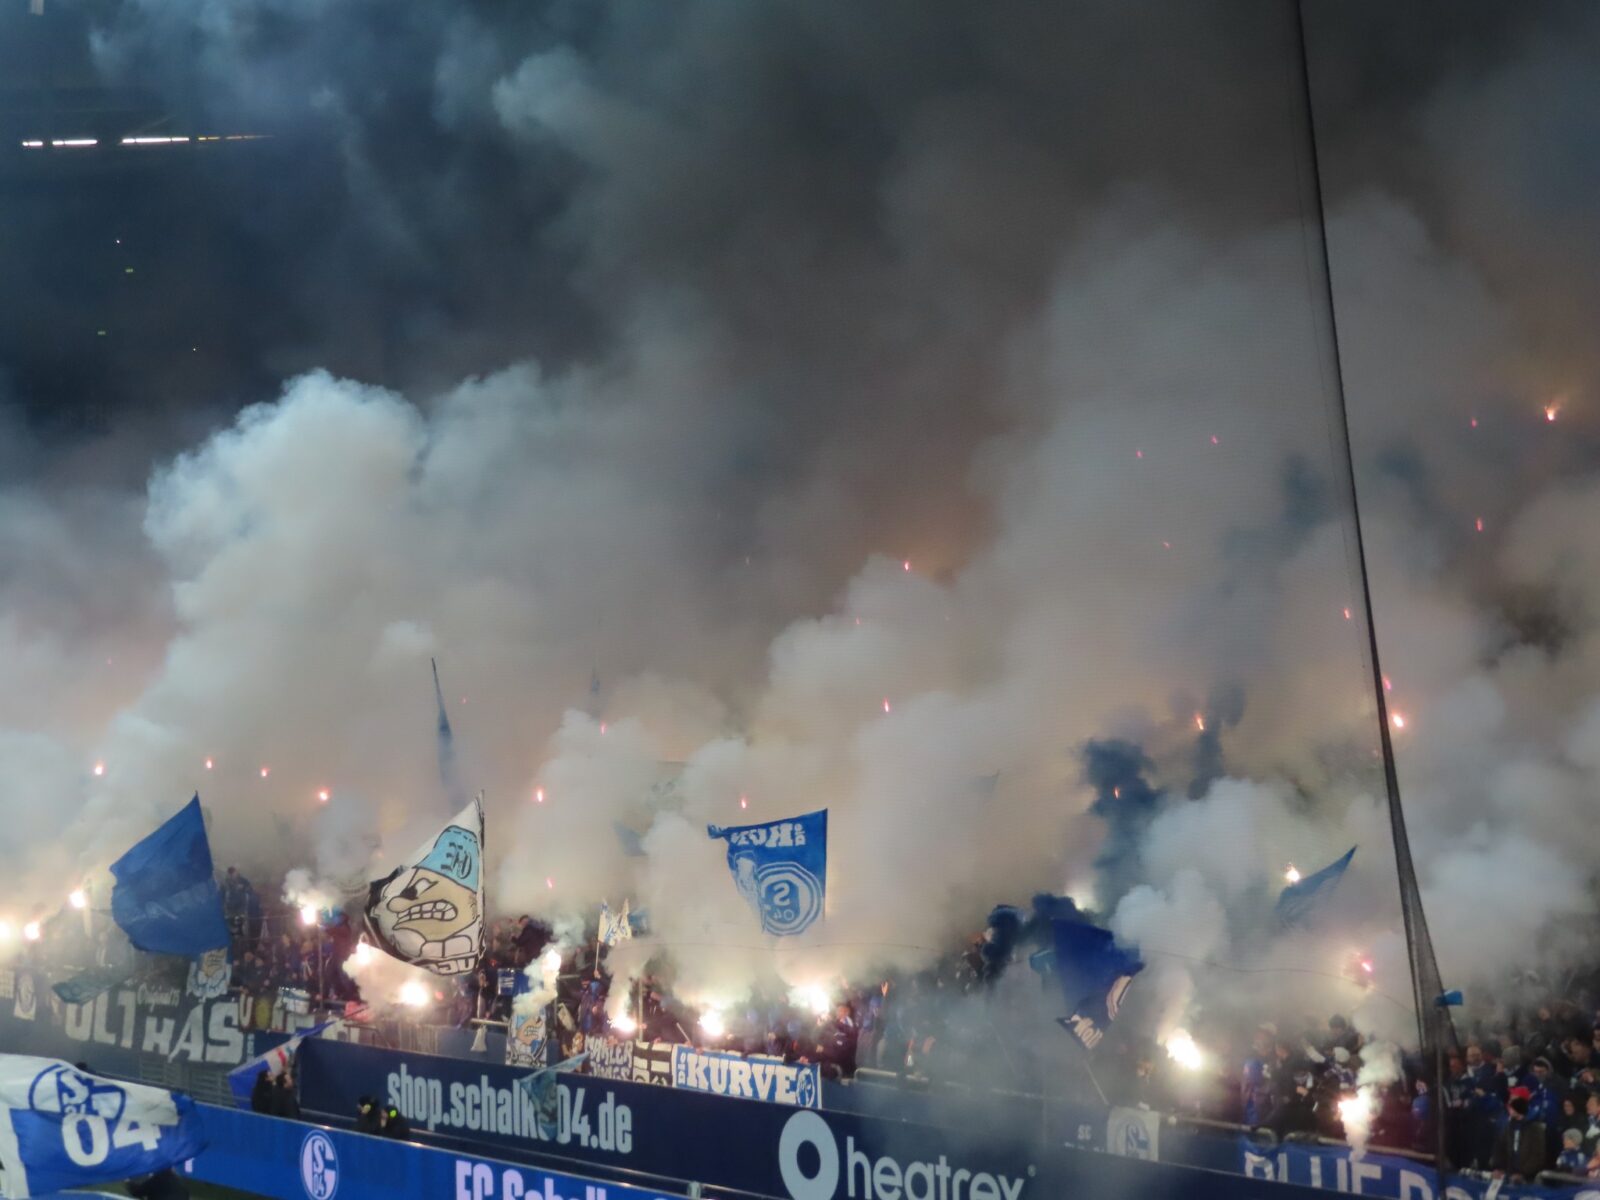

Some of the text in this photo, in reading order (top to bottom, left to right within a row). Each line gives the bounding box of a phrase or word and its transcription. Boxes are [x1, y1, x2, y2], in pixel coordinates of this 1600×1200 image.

[65, 990, 244, 1064] ULTRAS
[686, 1053, 798, 1105] KURVE
[62, 1113, 162, 1167] 04
